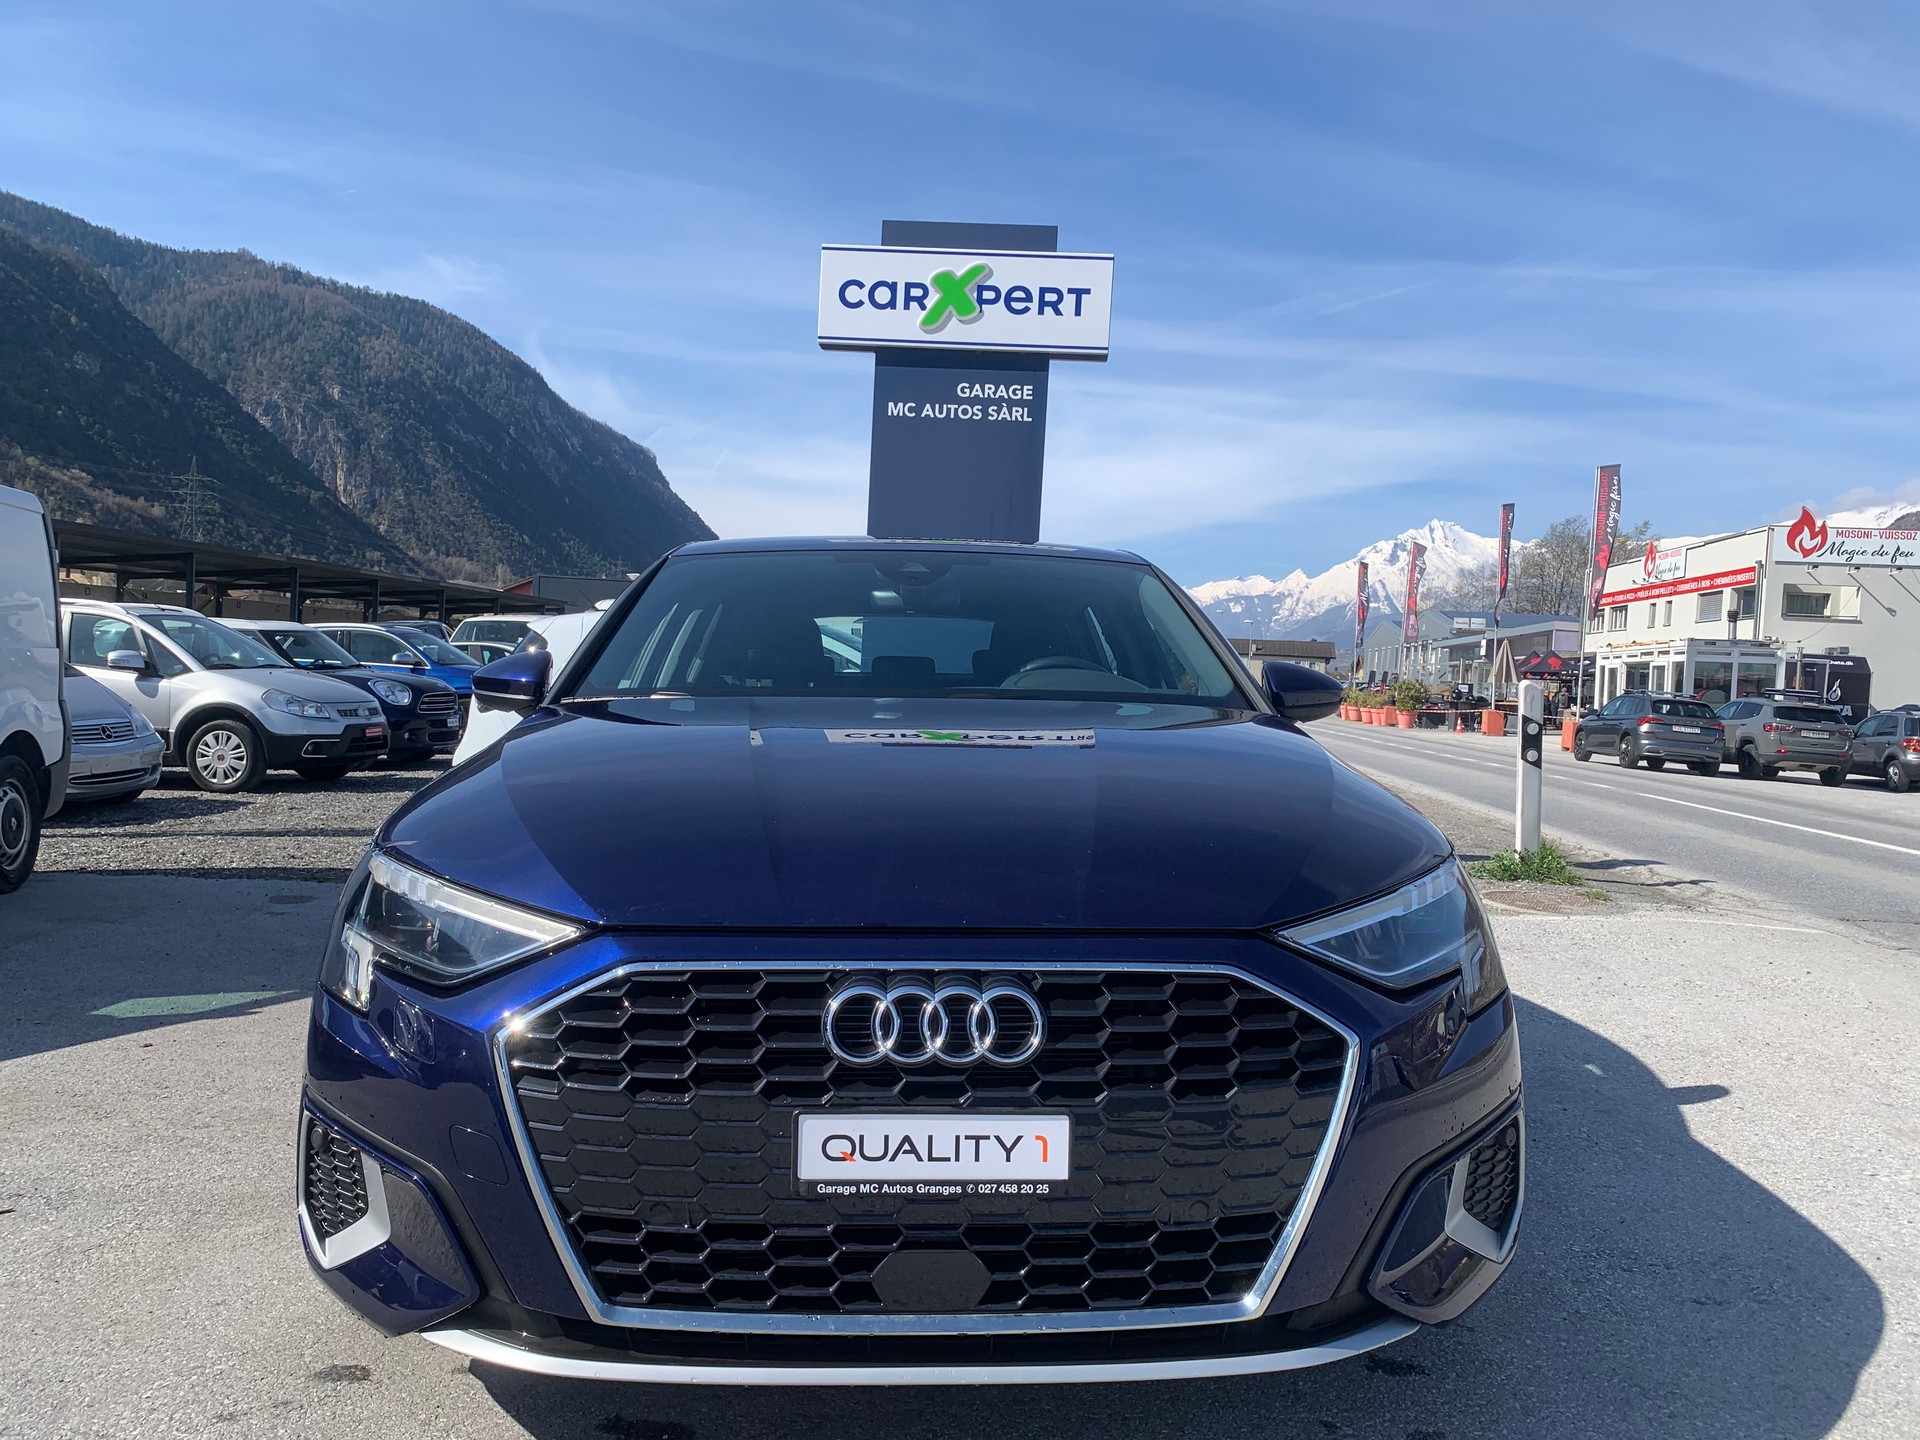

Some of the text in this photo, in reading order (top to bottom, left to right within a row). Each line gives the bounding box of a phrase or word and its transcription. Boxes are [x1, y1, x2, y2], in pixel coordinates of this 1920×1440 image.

[956, 382, 1034, 400] GARAGE
[887, 402, 1033, 422] MC AUTOS SÀRL
[1835, 529, 1918, 541] MOSONI-VUISSOZ
[1817, 540, 1916, 564] Magie du feu
[821, 1134, 1049, 1163] QUALITY 1
[816, 1183, 1050, 1195] Garage MC Autos Granges 027 458 20 25
